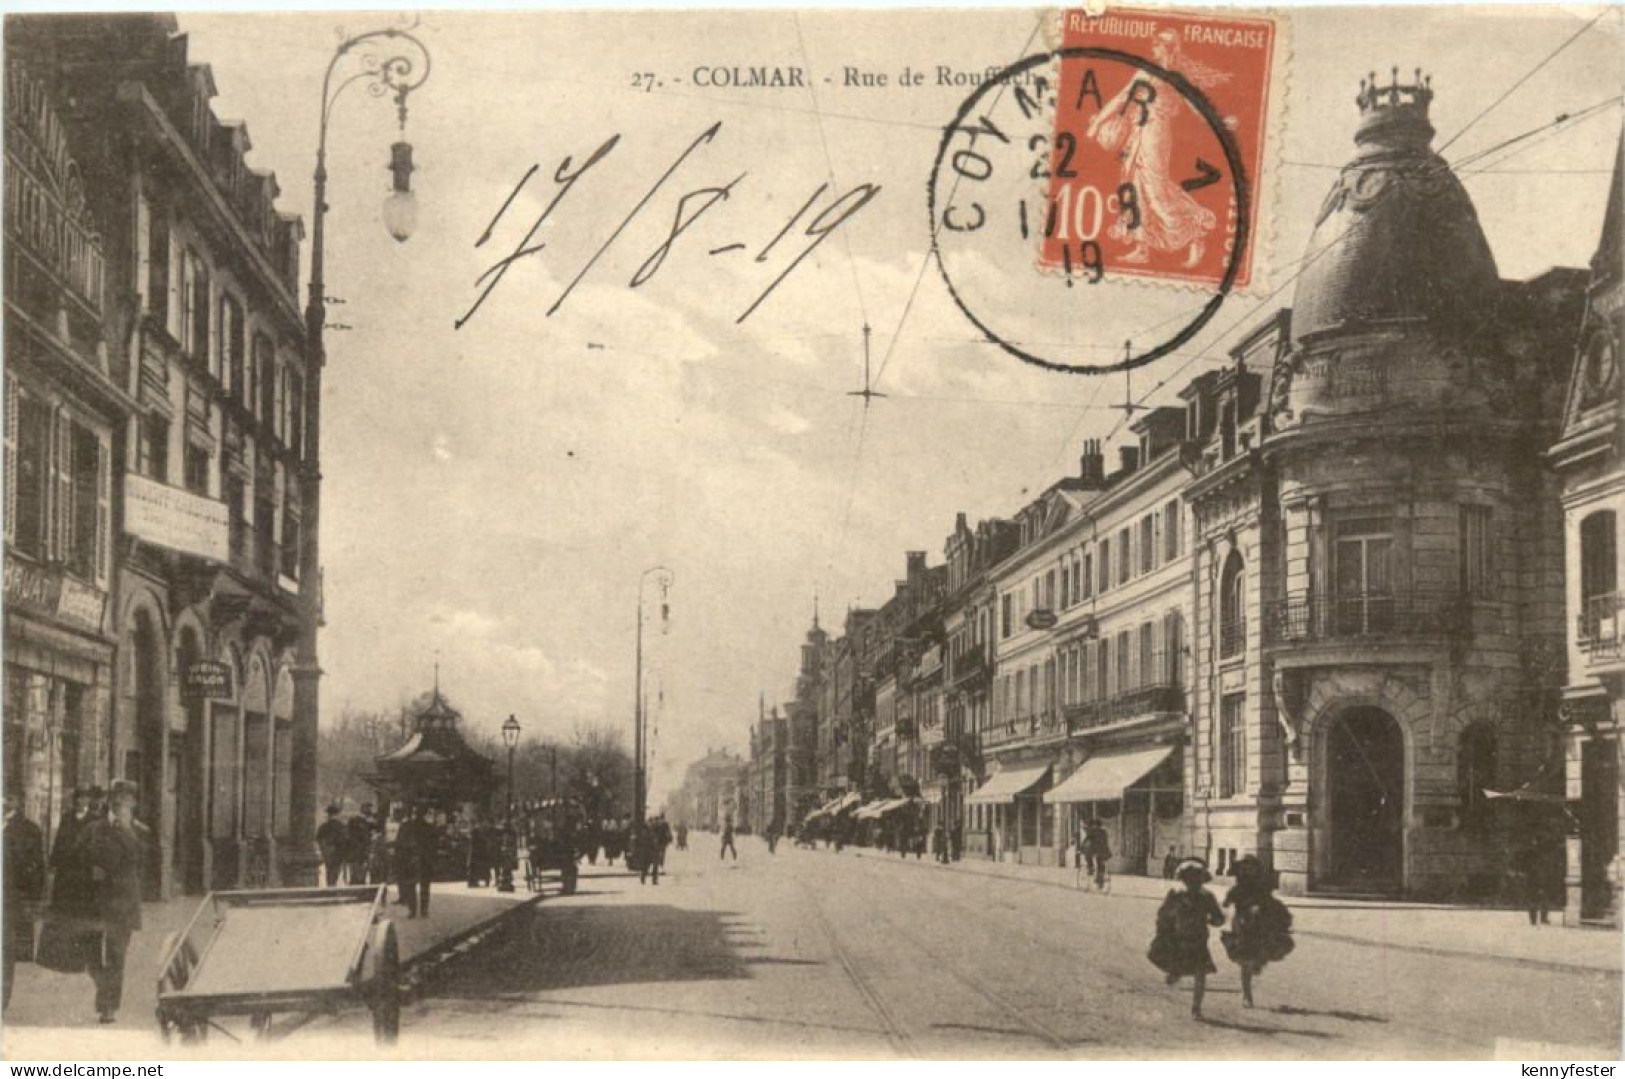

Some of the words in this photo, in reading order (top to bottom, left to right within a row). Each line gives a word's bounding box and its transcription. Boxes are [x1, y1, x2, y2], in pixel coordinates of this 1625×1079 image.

[630, 72, 663, 92] 27.
[843, 65, 888, 87] Rue
[899, 66, 925, 87] de
[1029, 132, 1077, 178] 22
[1063, 240, 1104, 287] 19
